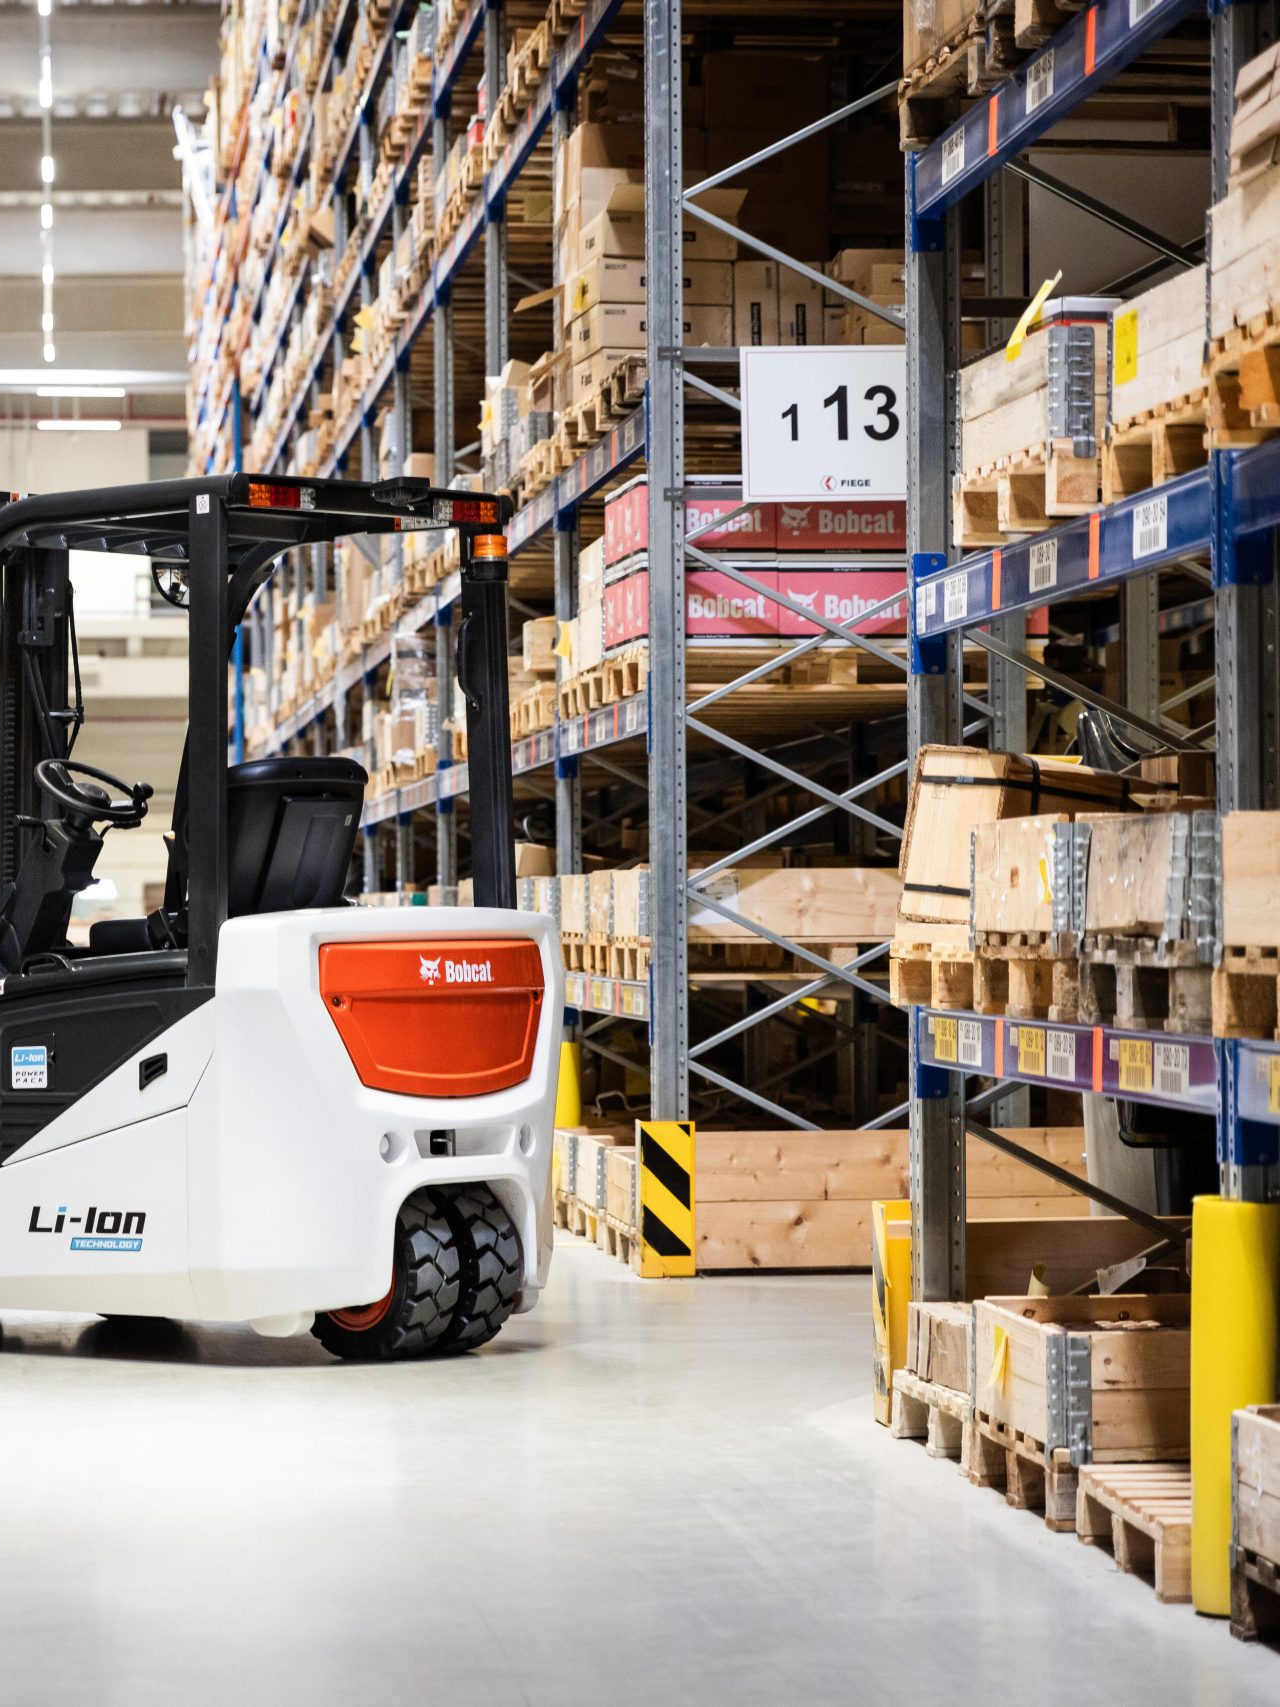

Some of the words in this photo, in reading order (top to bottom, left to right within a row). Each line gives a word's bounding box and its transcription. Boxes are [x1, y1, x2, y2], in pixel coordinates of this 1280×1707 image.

[782, 403, 799, 441] 1
[824, 385, 900, 441] 13
[841, 479, 871, 487] FIEGE
[820, 510, 895, 534] Bobcat
[689, 594, 765, 619] Bobcat
[445, 960, 492, 982] Bobcat
[14, 1053, 44, 1063] Li-Ion
[28, 1206, 146, 1234] Li-Ion
[74, 1239, 140, 1250] TECHNOLOGY
